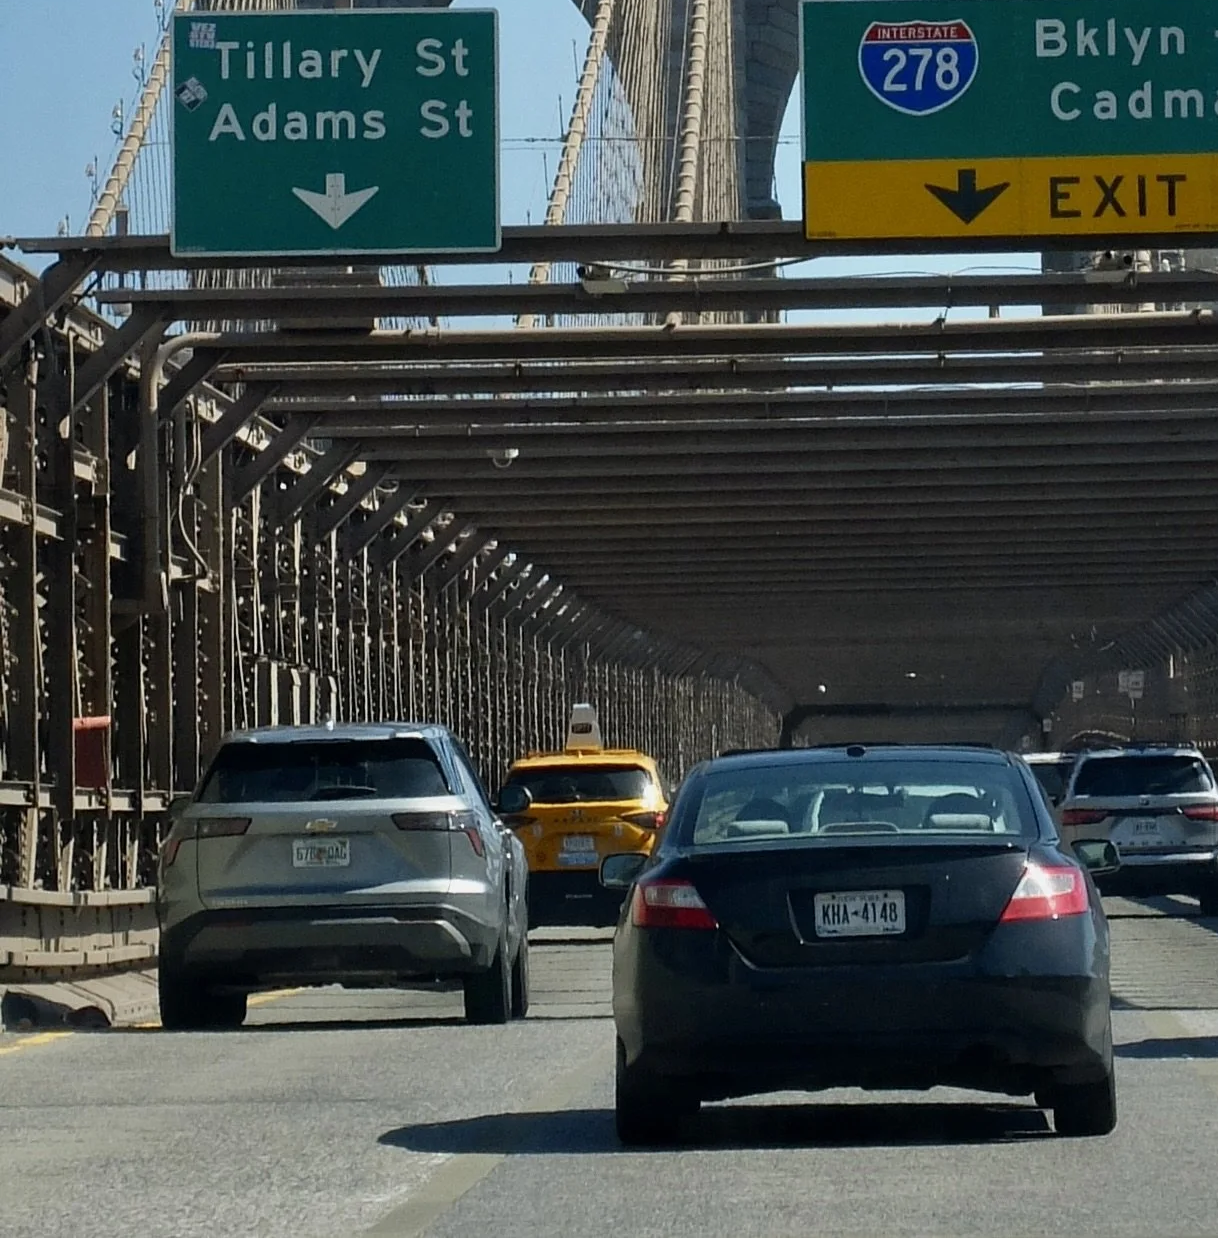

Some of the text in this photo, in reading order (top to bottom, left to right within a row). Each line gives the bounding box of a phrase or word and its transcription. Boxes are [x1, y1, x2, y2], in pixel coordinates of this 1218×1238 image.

[877, 26, 958, 39] INTERSTATE
[1035, 18, 1185, 66] Bklyn
[215, 38, 469, 88] Tillary St
[882, 47, 960, 92] 278
[208, 99, 473, 142] Adams St
[1049, 174, 1187, 219] EXIT
